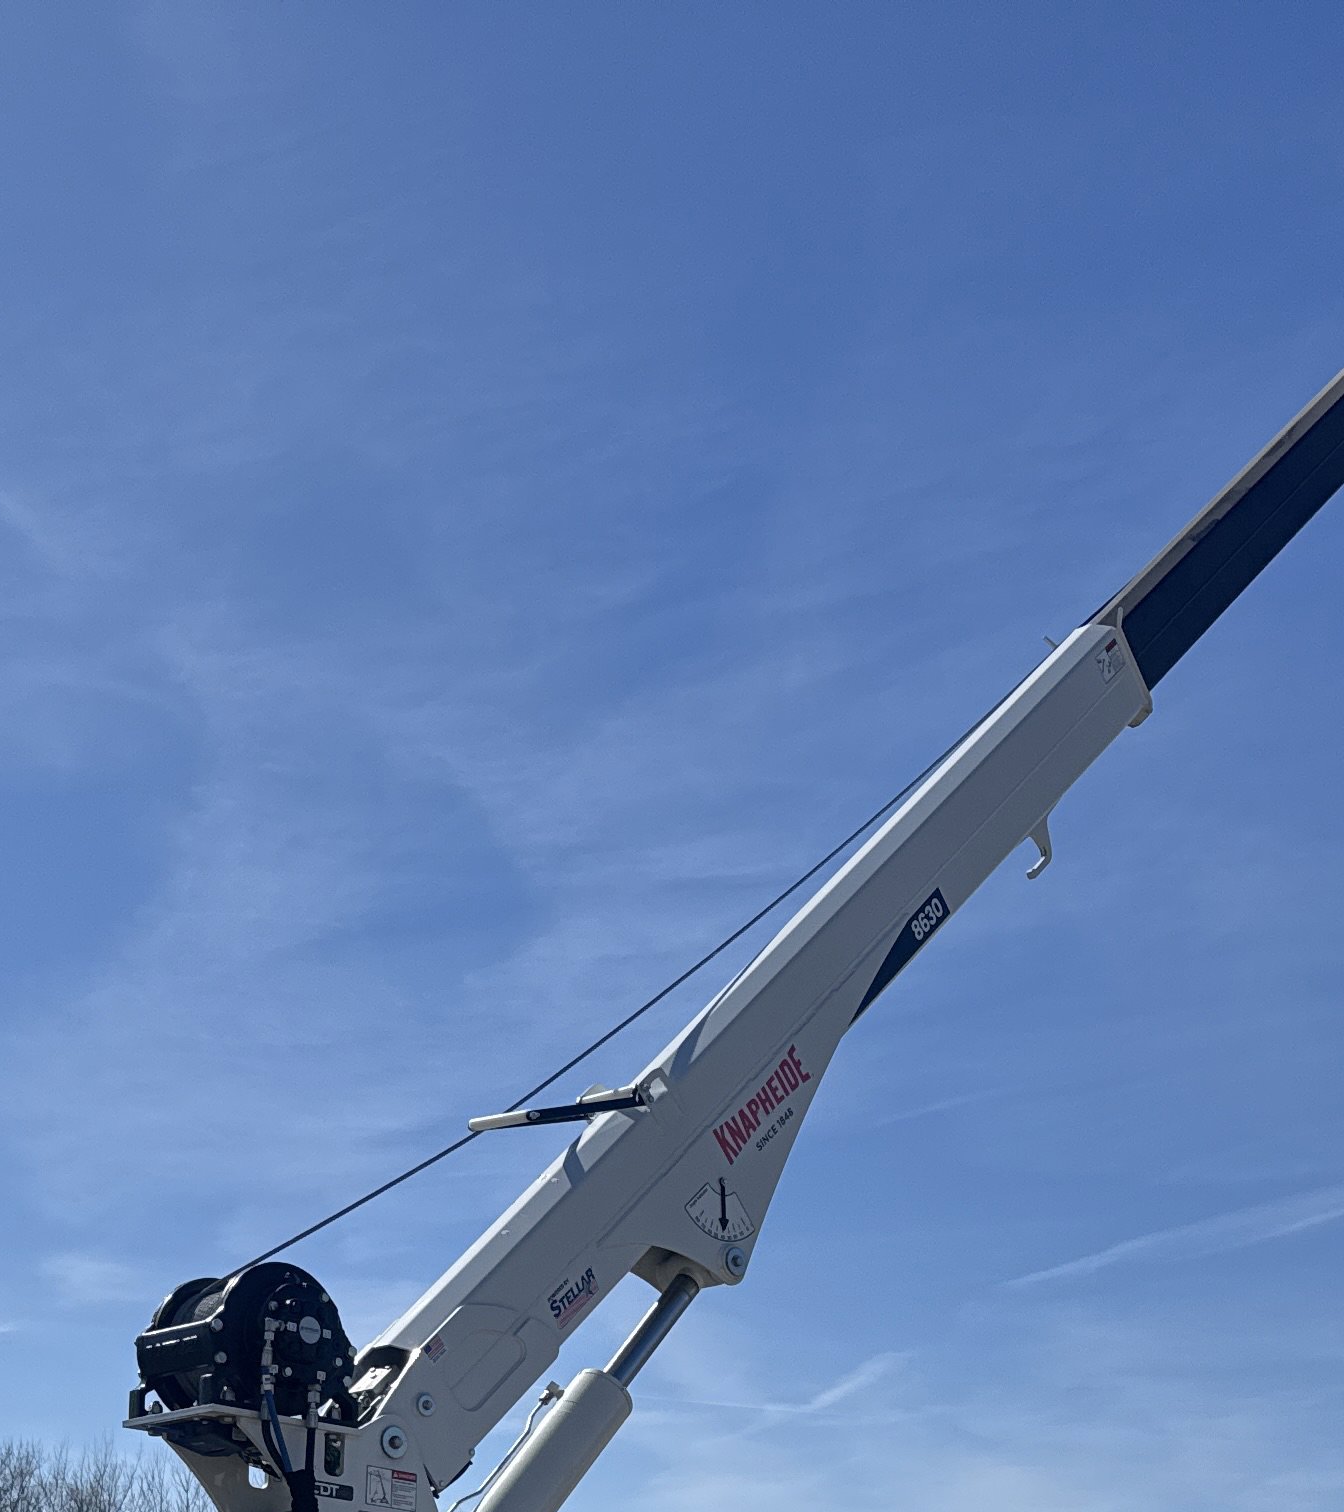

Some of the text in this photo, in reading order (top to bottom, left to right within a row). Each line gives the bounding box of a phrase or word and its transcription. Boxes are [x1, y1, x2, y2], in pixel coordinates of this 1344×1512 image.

[911, 897, 943, 940] 8630
[712, 1044, 811, 1165] KNAPHEIDE
[756, 1124, 779, 1152] SINCE
[549, 1267, 596, 1319] STELLAR
